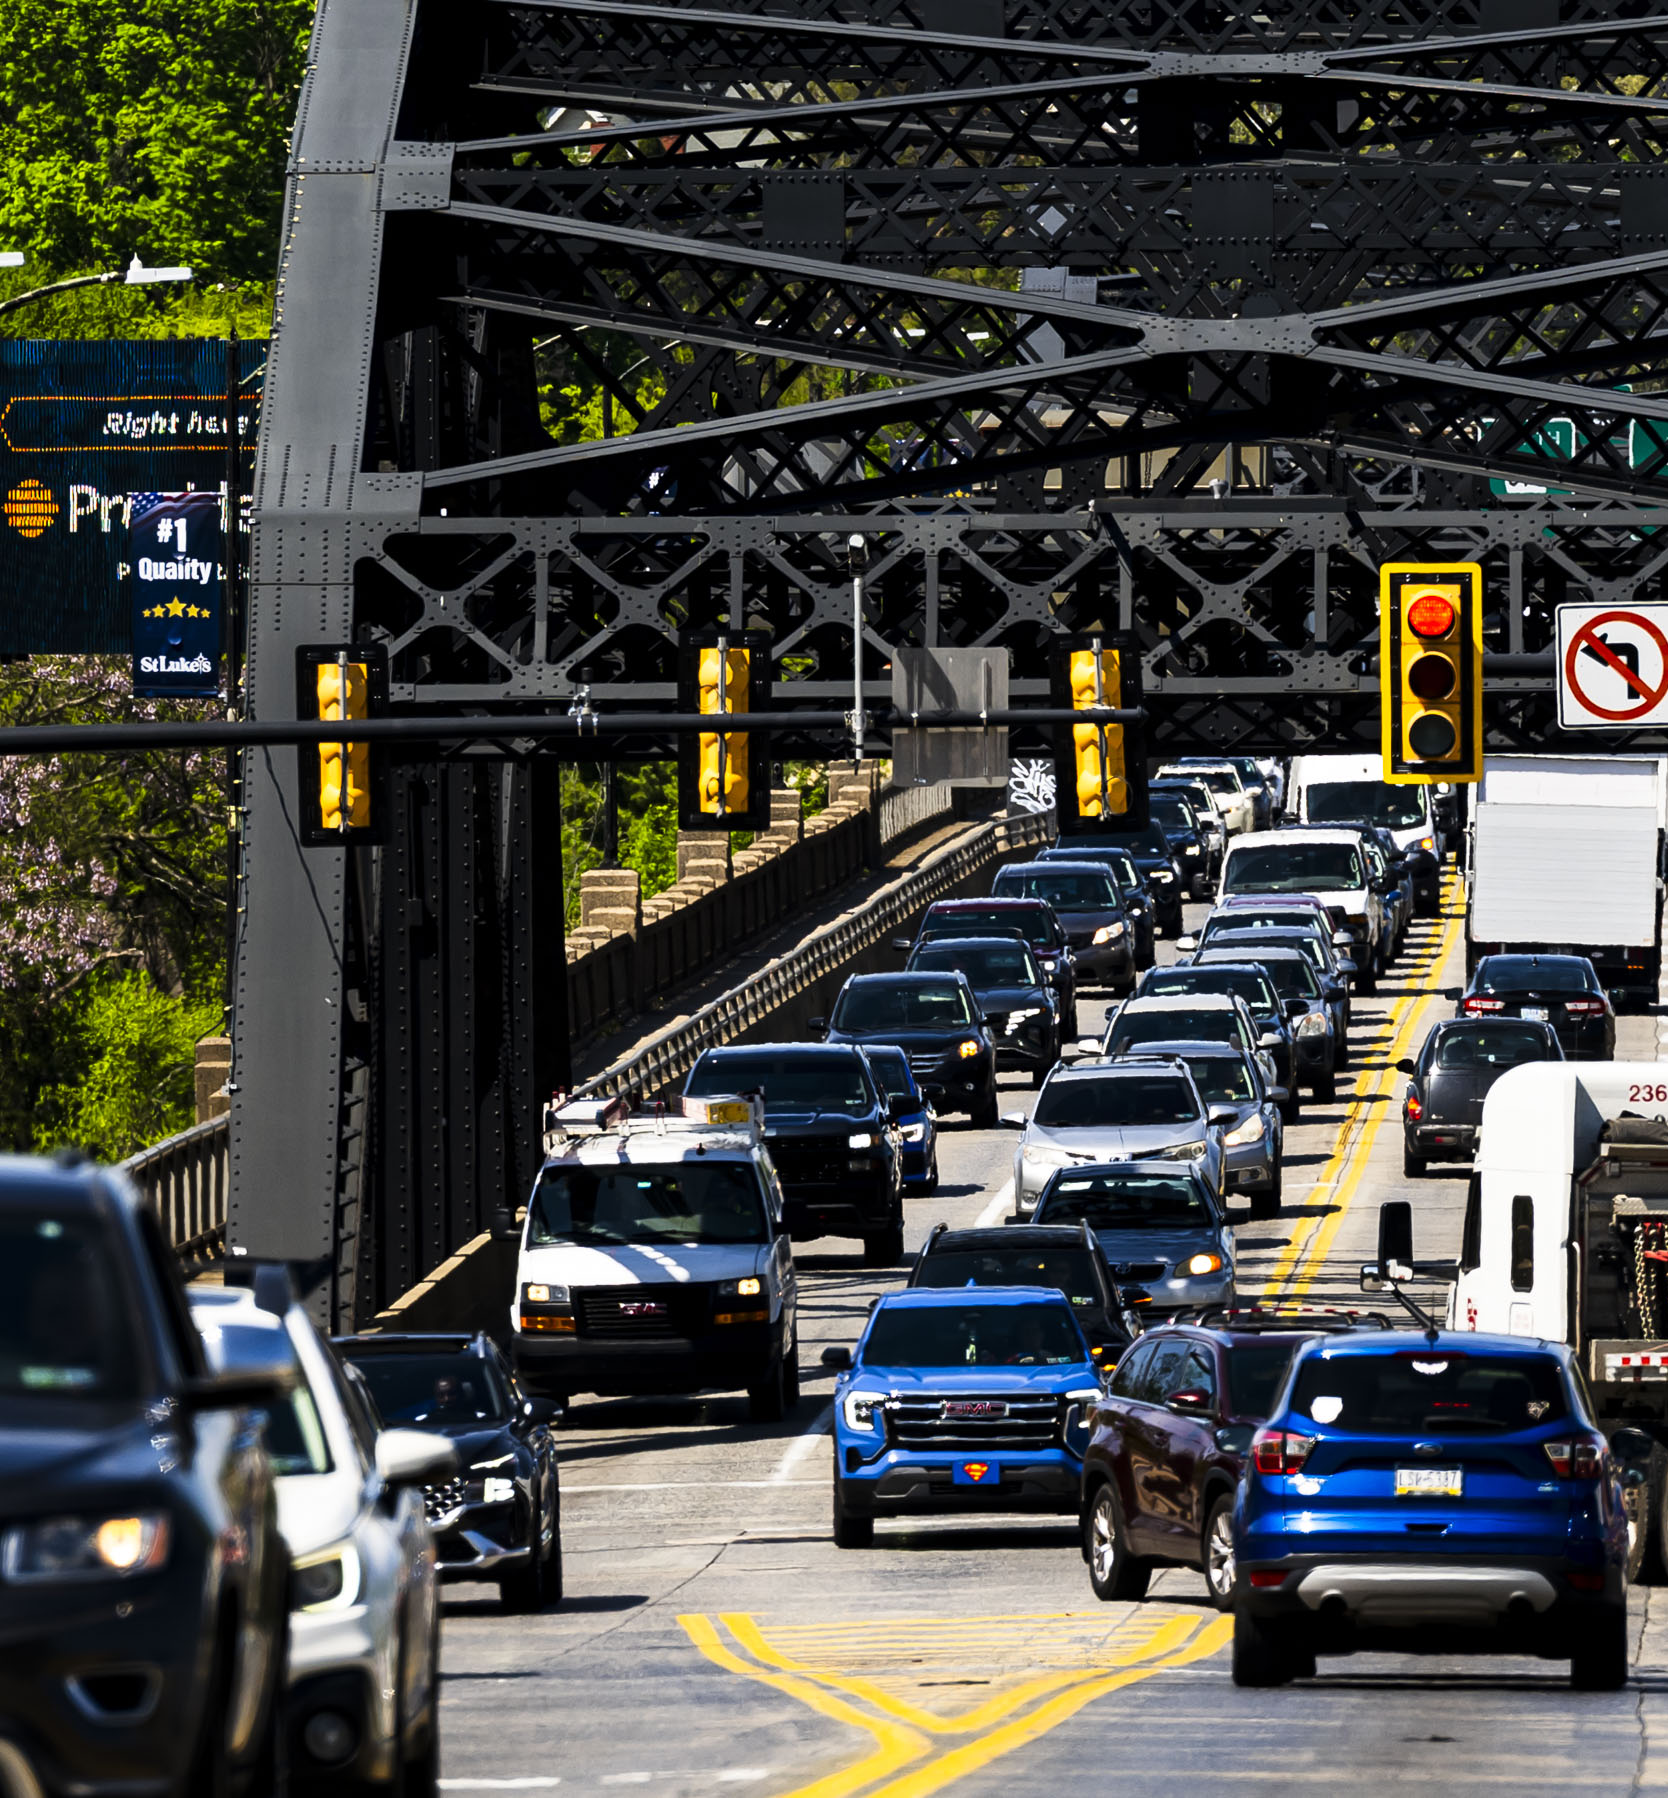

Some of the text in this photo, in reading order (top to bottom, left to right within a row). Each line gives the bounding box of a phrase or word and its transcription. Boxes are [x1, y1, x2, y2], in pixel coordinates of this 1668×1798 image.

[156, 517, 187, 552] #1
[138, 557, 212, 584] Quality
[946, 1402, 1005, 1416] GMC
